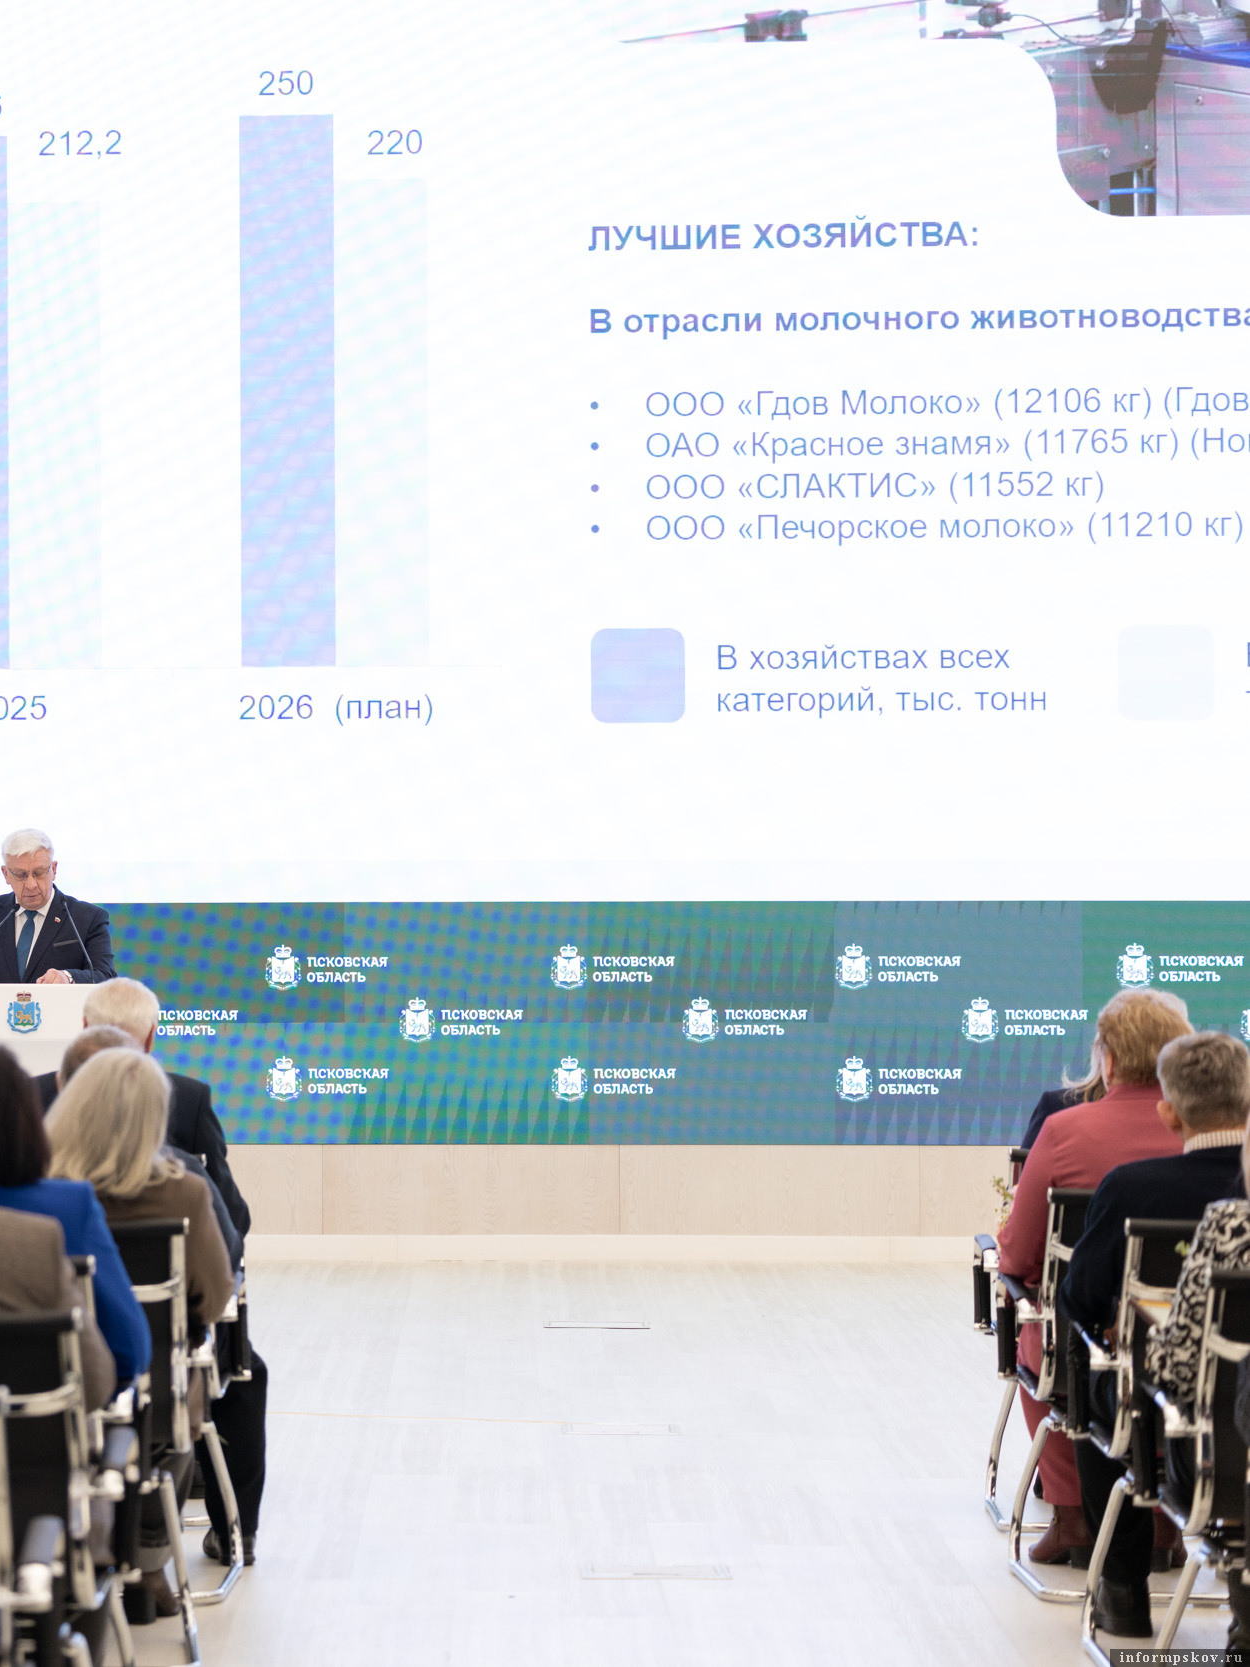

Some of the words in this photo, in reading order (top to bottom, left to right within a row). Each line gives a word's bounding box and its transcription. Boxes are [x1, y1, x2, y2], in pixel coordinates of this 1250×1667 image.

[258, 70, 314, 96] 250
[38, 129, 122, 159] 212,2
[367, 129, 423, 156] 220
[587, 223, 741, 252] ЛУЧШИЕ
[752, 215, 978, 249] ХОЗЯЙСТВА:
[589, 308, 612, 334] В
[623, 312, 762, 341] отрасли
[775, 310, 960, 332] молочного
[645, 391, 725, 417] ООО
[737, 390, 829, 421] «Гдов
[841, 389, 980, 416] Молоко»
[994, 387, 1101, 421] (12106
[1113, 387, 1152, 420] кг)
[646, 431, 720, 458] ОАО
[732, 431, 884, 464] «Красное
[895, 435, 1010, 456] знамя»
[1024, 428, 1128, 462] (11765
[1140, 428, 1179, 461] кг)
[1191, 427, 1250, 460] (Но
[646, 473, 725, 500] ООО
[738, 472, 936, 499] «СЛАКТИС»
[949, 471, 1053, 505] (11552
[1066, 471, 1104, 503] кг)
[646, 514, 725, 541] ООО
[738, 513, 927, 547] «Печорское
[940, 518, 1074, 539] молоко»
[1087, 511, 1193, 545] (11210
[1205, 511, 1243, 543] кг)
[717, 644, 738, 671] В
[749, 644, 928, 670] хозяйствах
[940, 649, 1010, 669] всех
[717, 686, 883, 720] категорий,
[895, 691, 962, 712] тыс.
[974, 691, 1046, 711] тонн
[239, 694, 313, 721] 2026
[335, 693, 433, 727] (план)
[306, 956, 389, 967] ПСКОВСКАЯ
[593, 956, 675, 967] ПСКОВСКАЯ
[878, 955, 962, 967] ПСКОВСКАЯ
[1159, 955, 1244, 967] ПСКОВСКАЯ
[306, 972, 367, 983] ОБЛАСТЬ
[593, 971, 653, 982] ОБЛАСТЬ
[877, 971, 939, 982] ОБЛАСТЬ
[1158, 971, 1221, 982] ОБЛАСТЬ
[157, 1009, 239, 1021] ПСКОВСКАЯ
[441, 1009, 524, 1020] ПСКОВСКАЯ
[725, 1009, 808, 1020] ПСКОВСКАЯ
[1005, 1009, 1089, 1020] ПСКОВСКАЯ
[156, 1025, 216, 1036] ОБЛАСТЬ
[440, 1025, 501, 1036] ОБЛАСТЬ
[724, 1024, 785, 1036] ОБЛАСТЬ
[1004, 1024, 1066, 1036] ОБЛАСТЬ
[308, 1068, 390, 1079] ПСКОВСКАЯ
[594, 1068, 677, 1080] ПСКОВСКАЯ
[878, 1068, 962, 1080] ПСКОВСКАЯ
[307, 1084, 368, 1094] ОБЛАСТЬ
[593, 1084, 654, 1095] ОБЛАСТЬ
[878, 1084, 939, 1095] ОБЛАСТЬ
